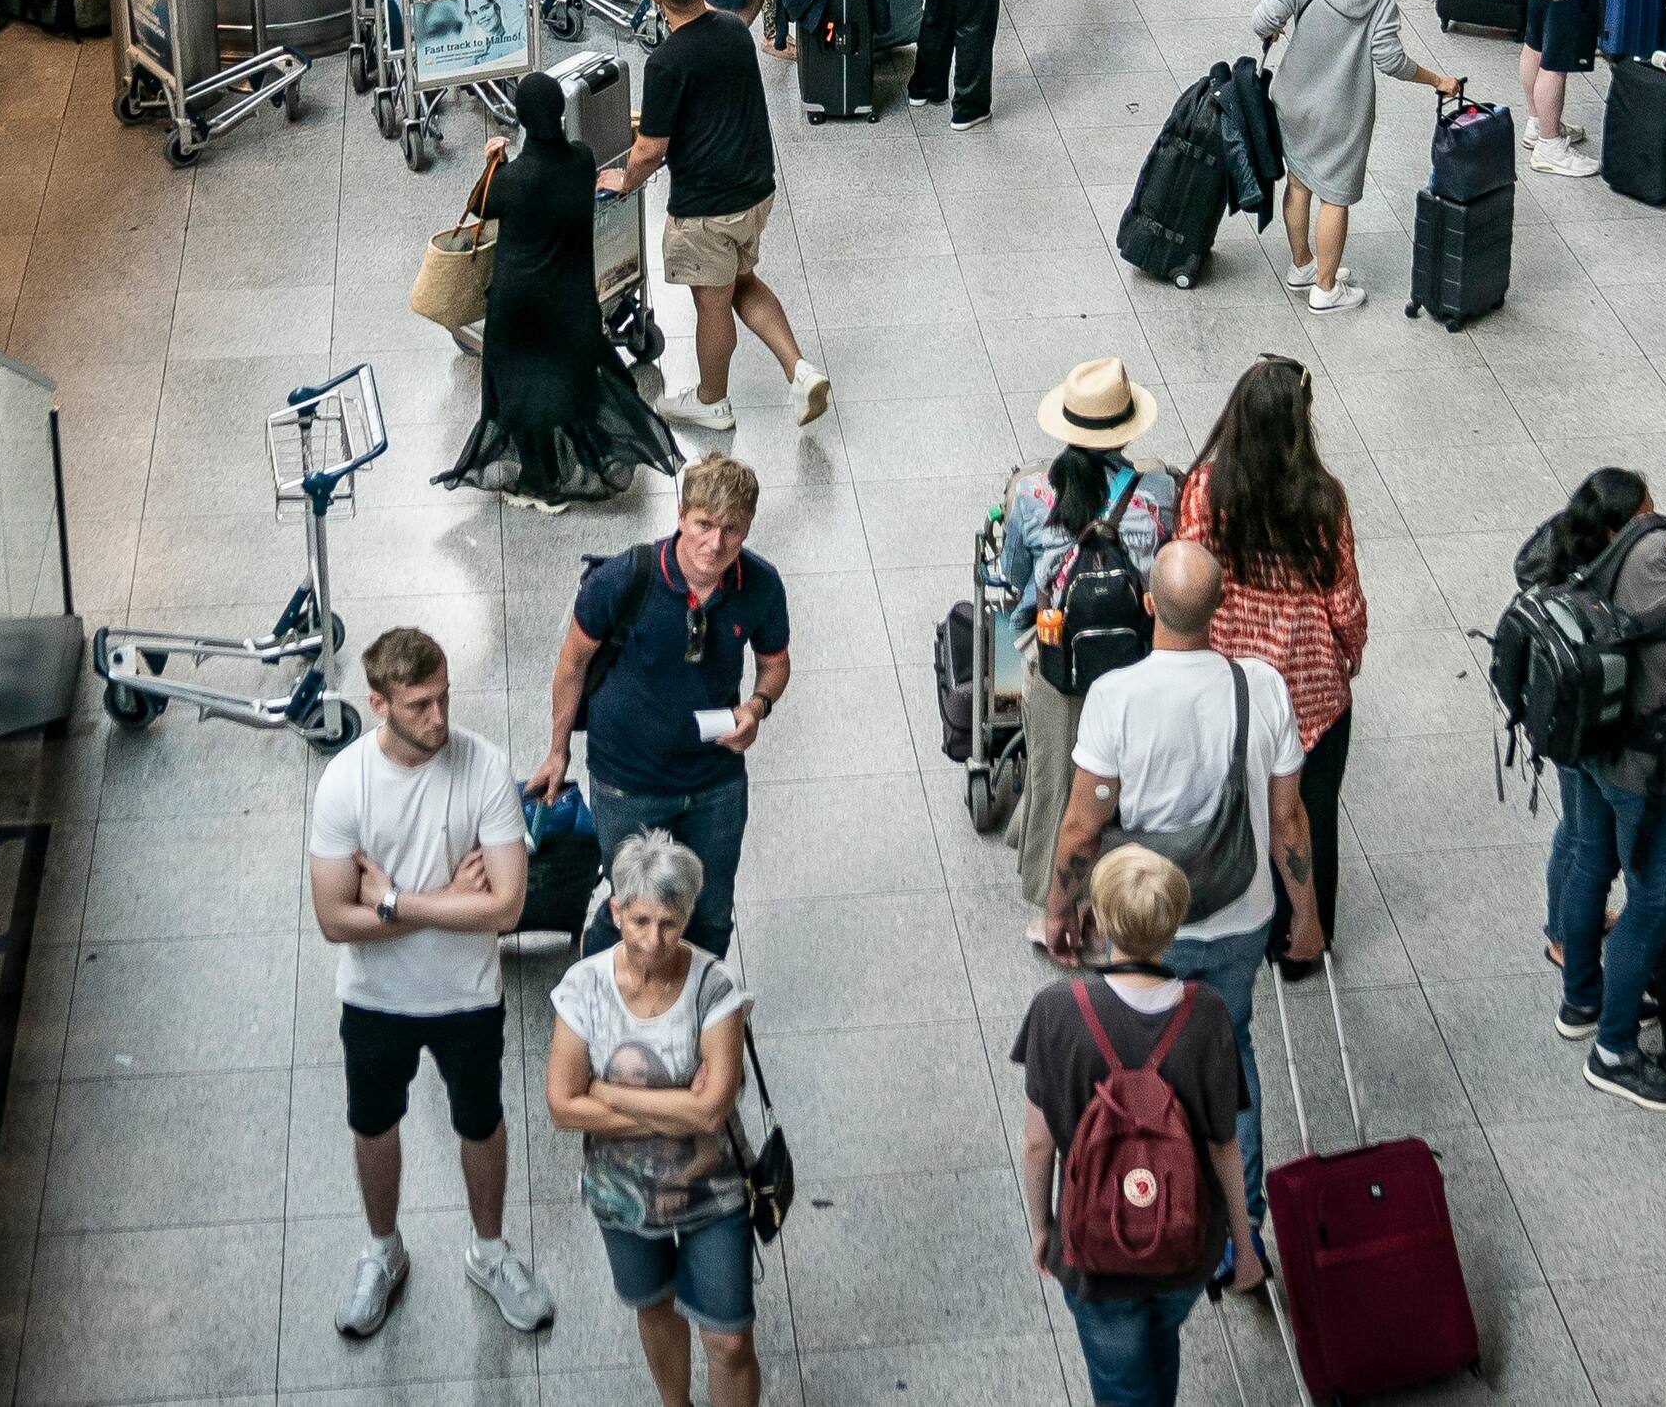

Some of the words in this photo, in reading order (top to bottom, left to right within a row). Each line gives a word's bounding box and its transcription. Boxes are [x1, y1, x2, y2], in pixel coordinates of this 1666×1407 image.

[424, 46, 445, 55] Fast
[446, 39, 471, 52] track
[473, 39, 483, 48] to
[485, 32, 522, 47] Malmö!
